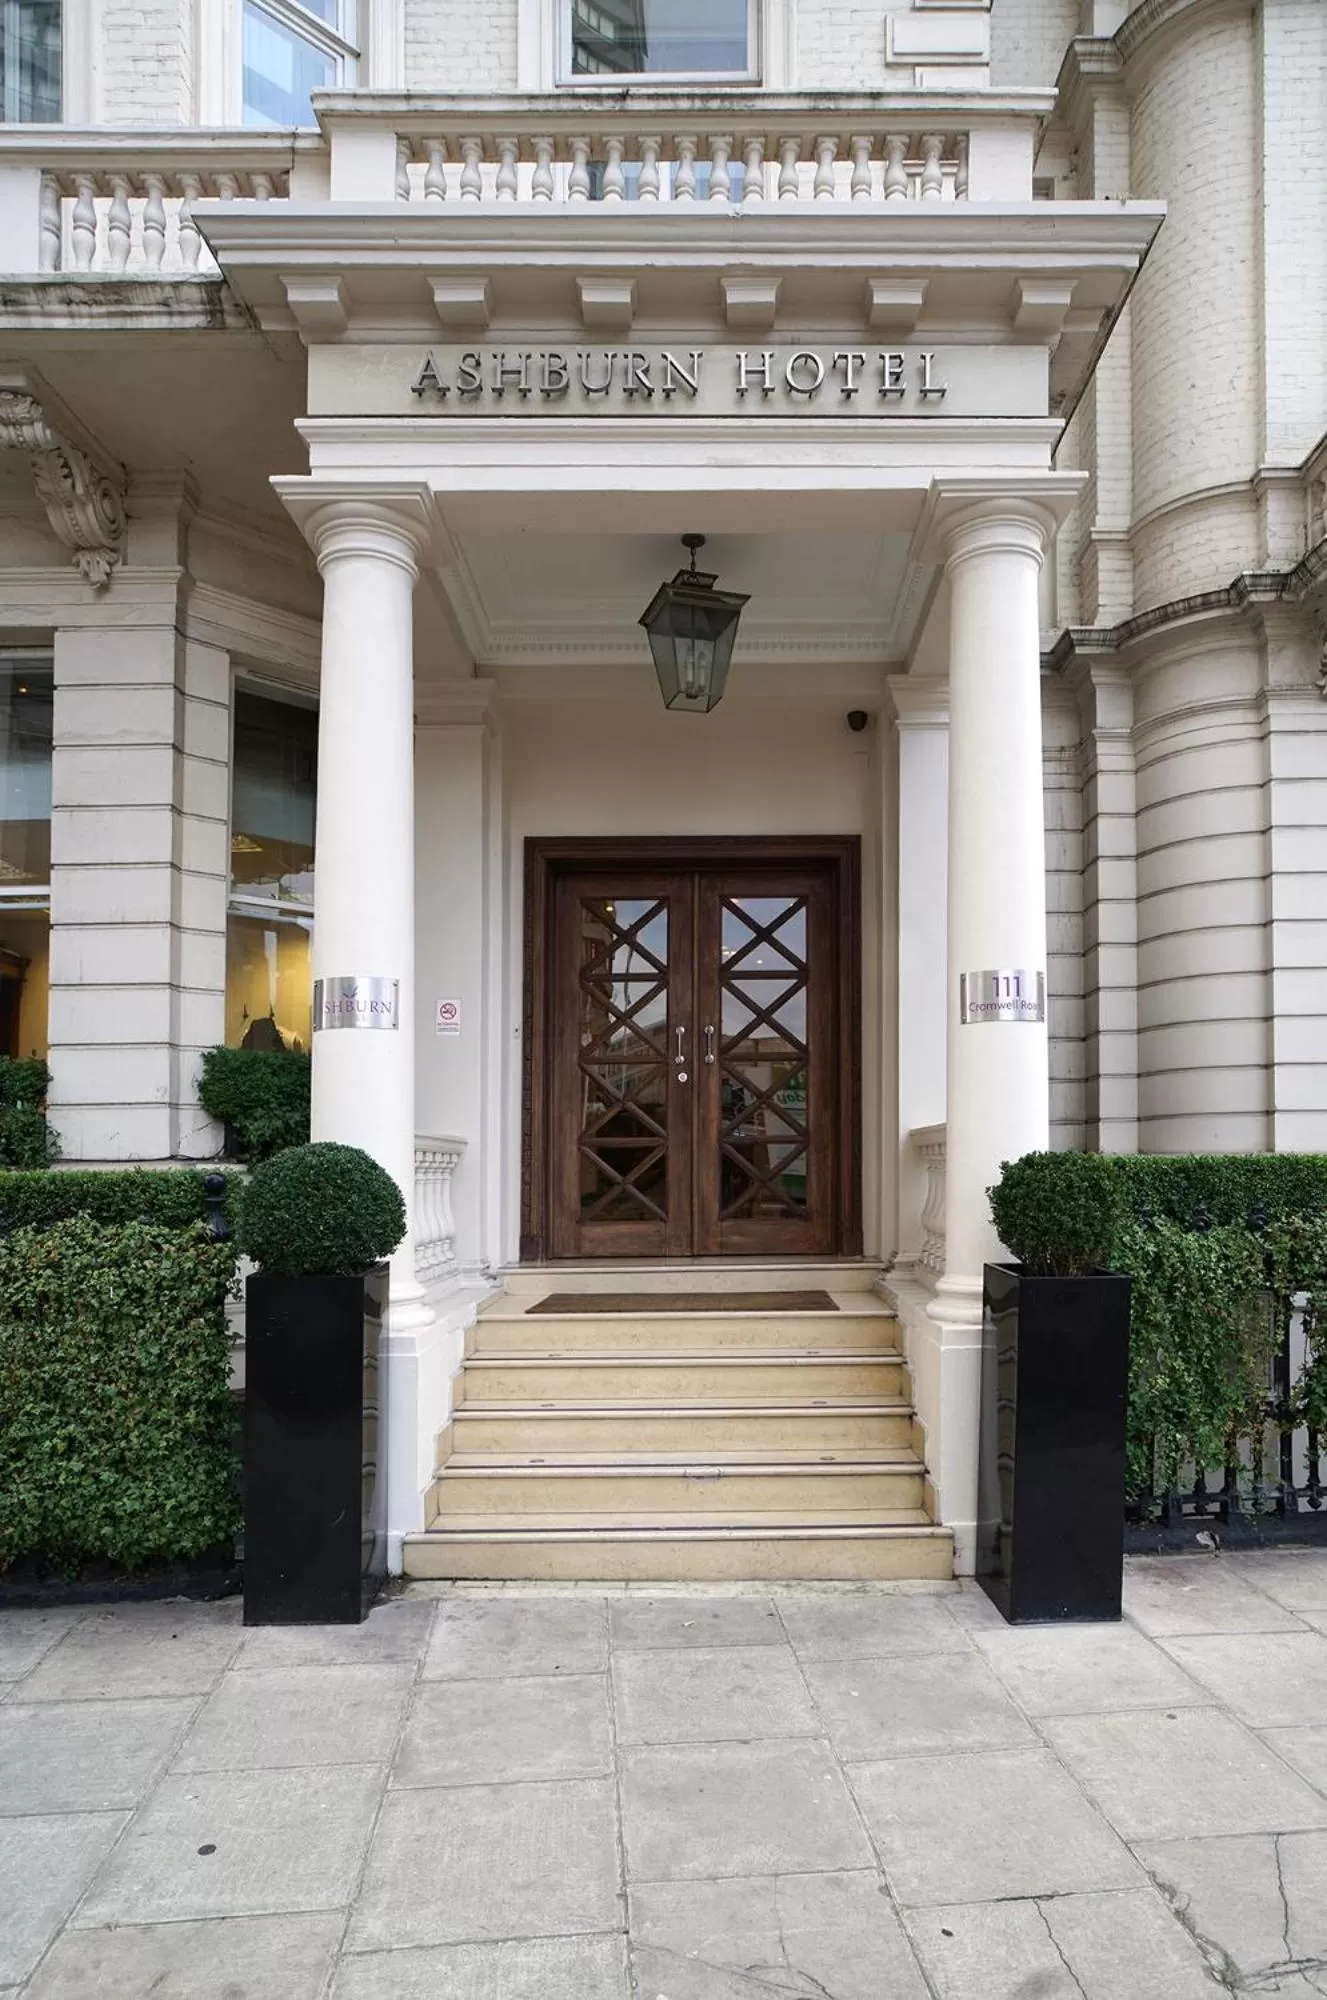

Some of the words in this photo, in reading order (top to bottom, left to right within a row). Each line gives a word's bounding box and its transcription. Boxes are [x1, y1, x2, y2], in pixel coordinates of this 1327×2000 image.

[410, 351, 703, 398] ASHBURN
[736, 351, 949, 398] HOTEL
[991, 976, 1020, 997] 111
[323, 1000, 393, 1015] SHBURN
[968, 1000, 1019, 1012] Cromwell
